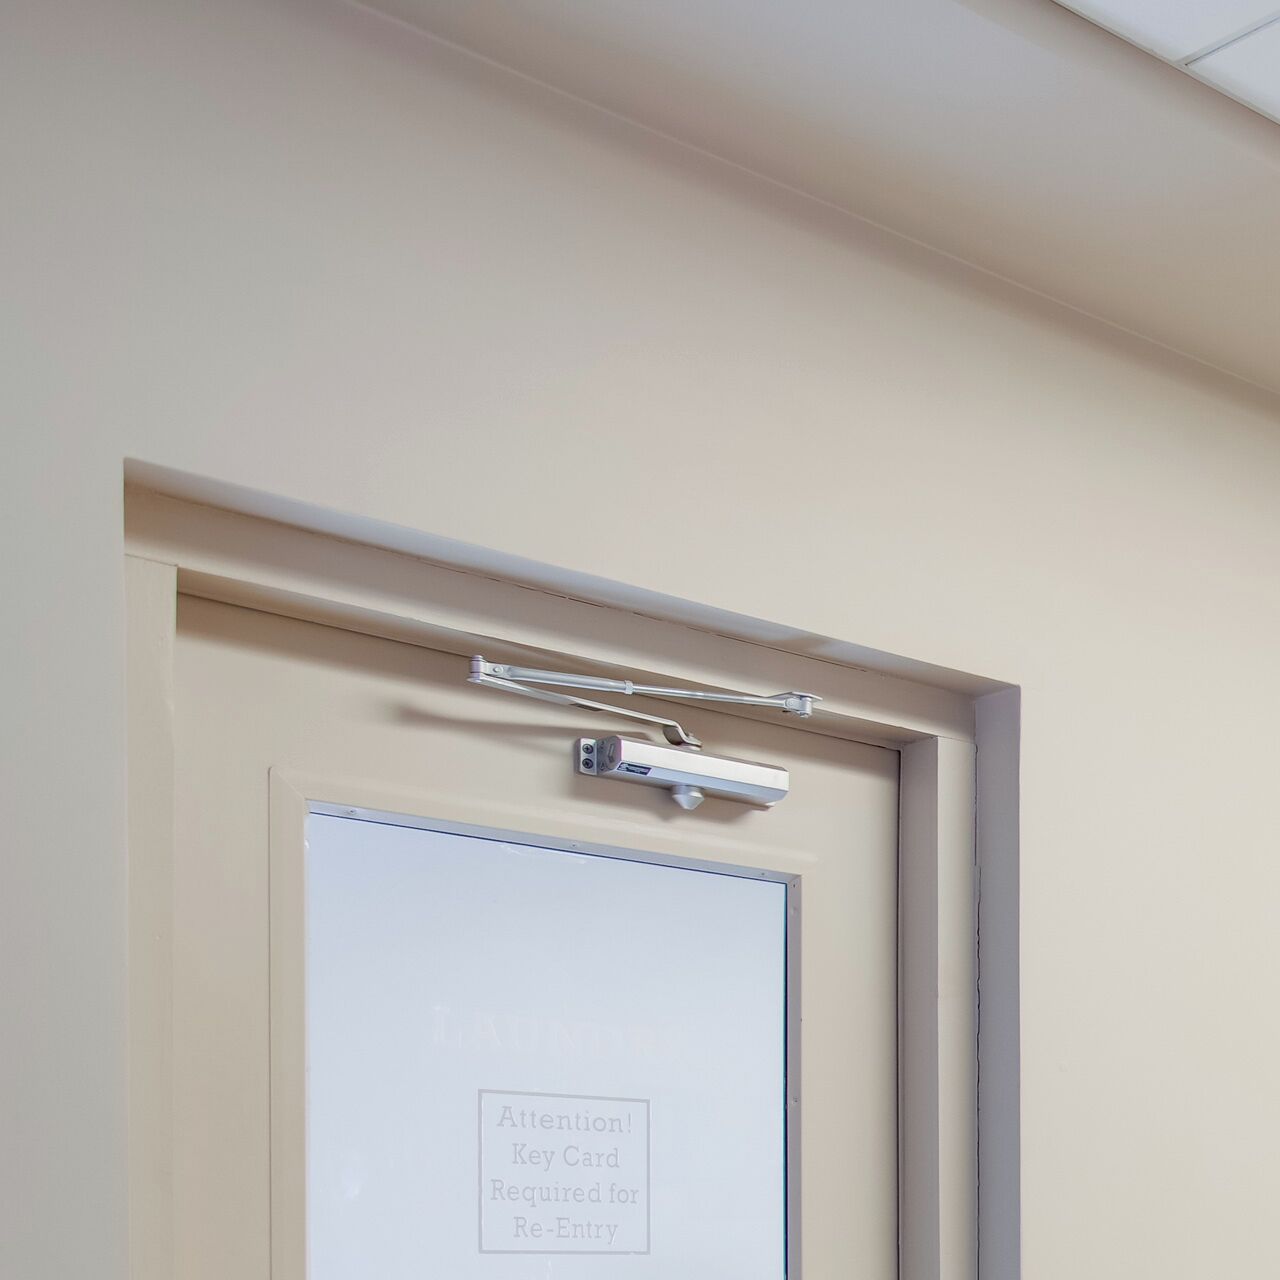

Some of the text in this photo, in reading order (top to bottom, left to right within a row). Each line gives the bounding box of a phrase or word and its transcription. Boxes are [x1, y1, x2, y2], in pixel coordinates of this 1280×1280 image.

[496, 1105, 632, 1134] Attention!
[512, 1142, 620, 1172] Key Card
[490, 1178, 639, 1208] Required for
[513, 1216, 619, 1245] Re-Entry
